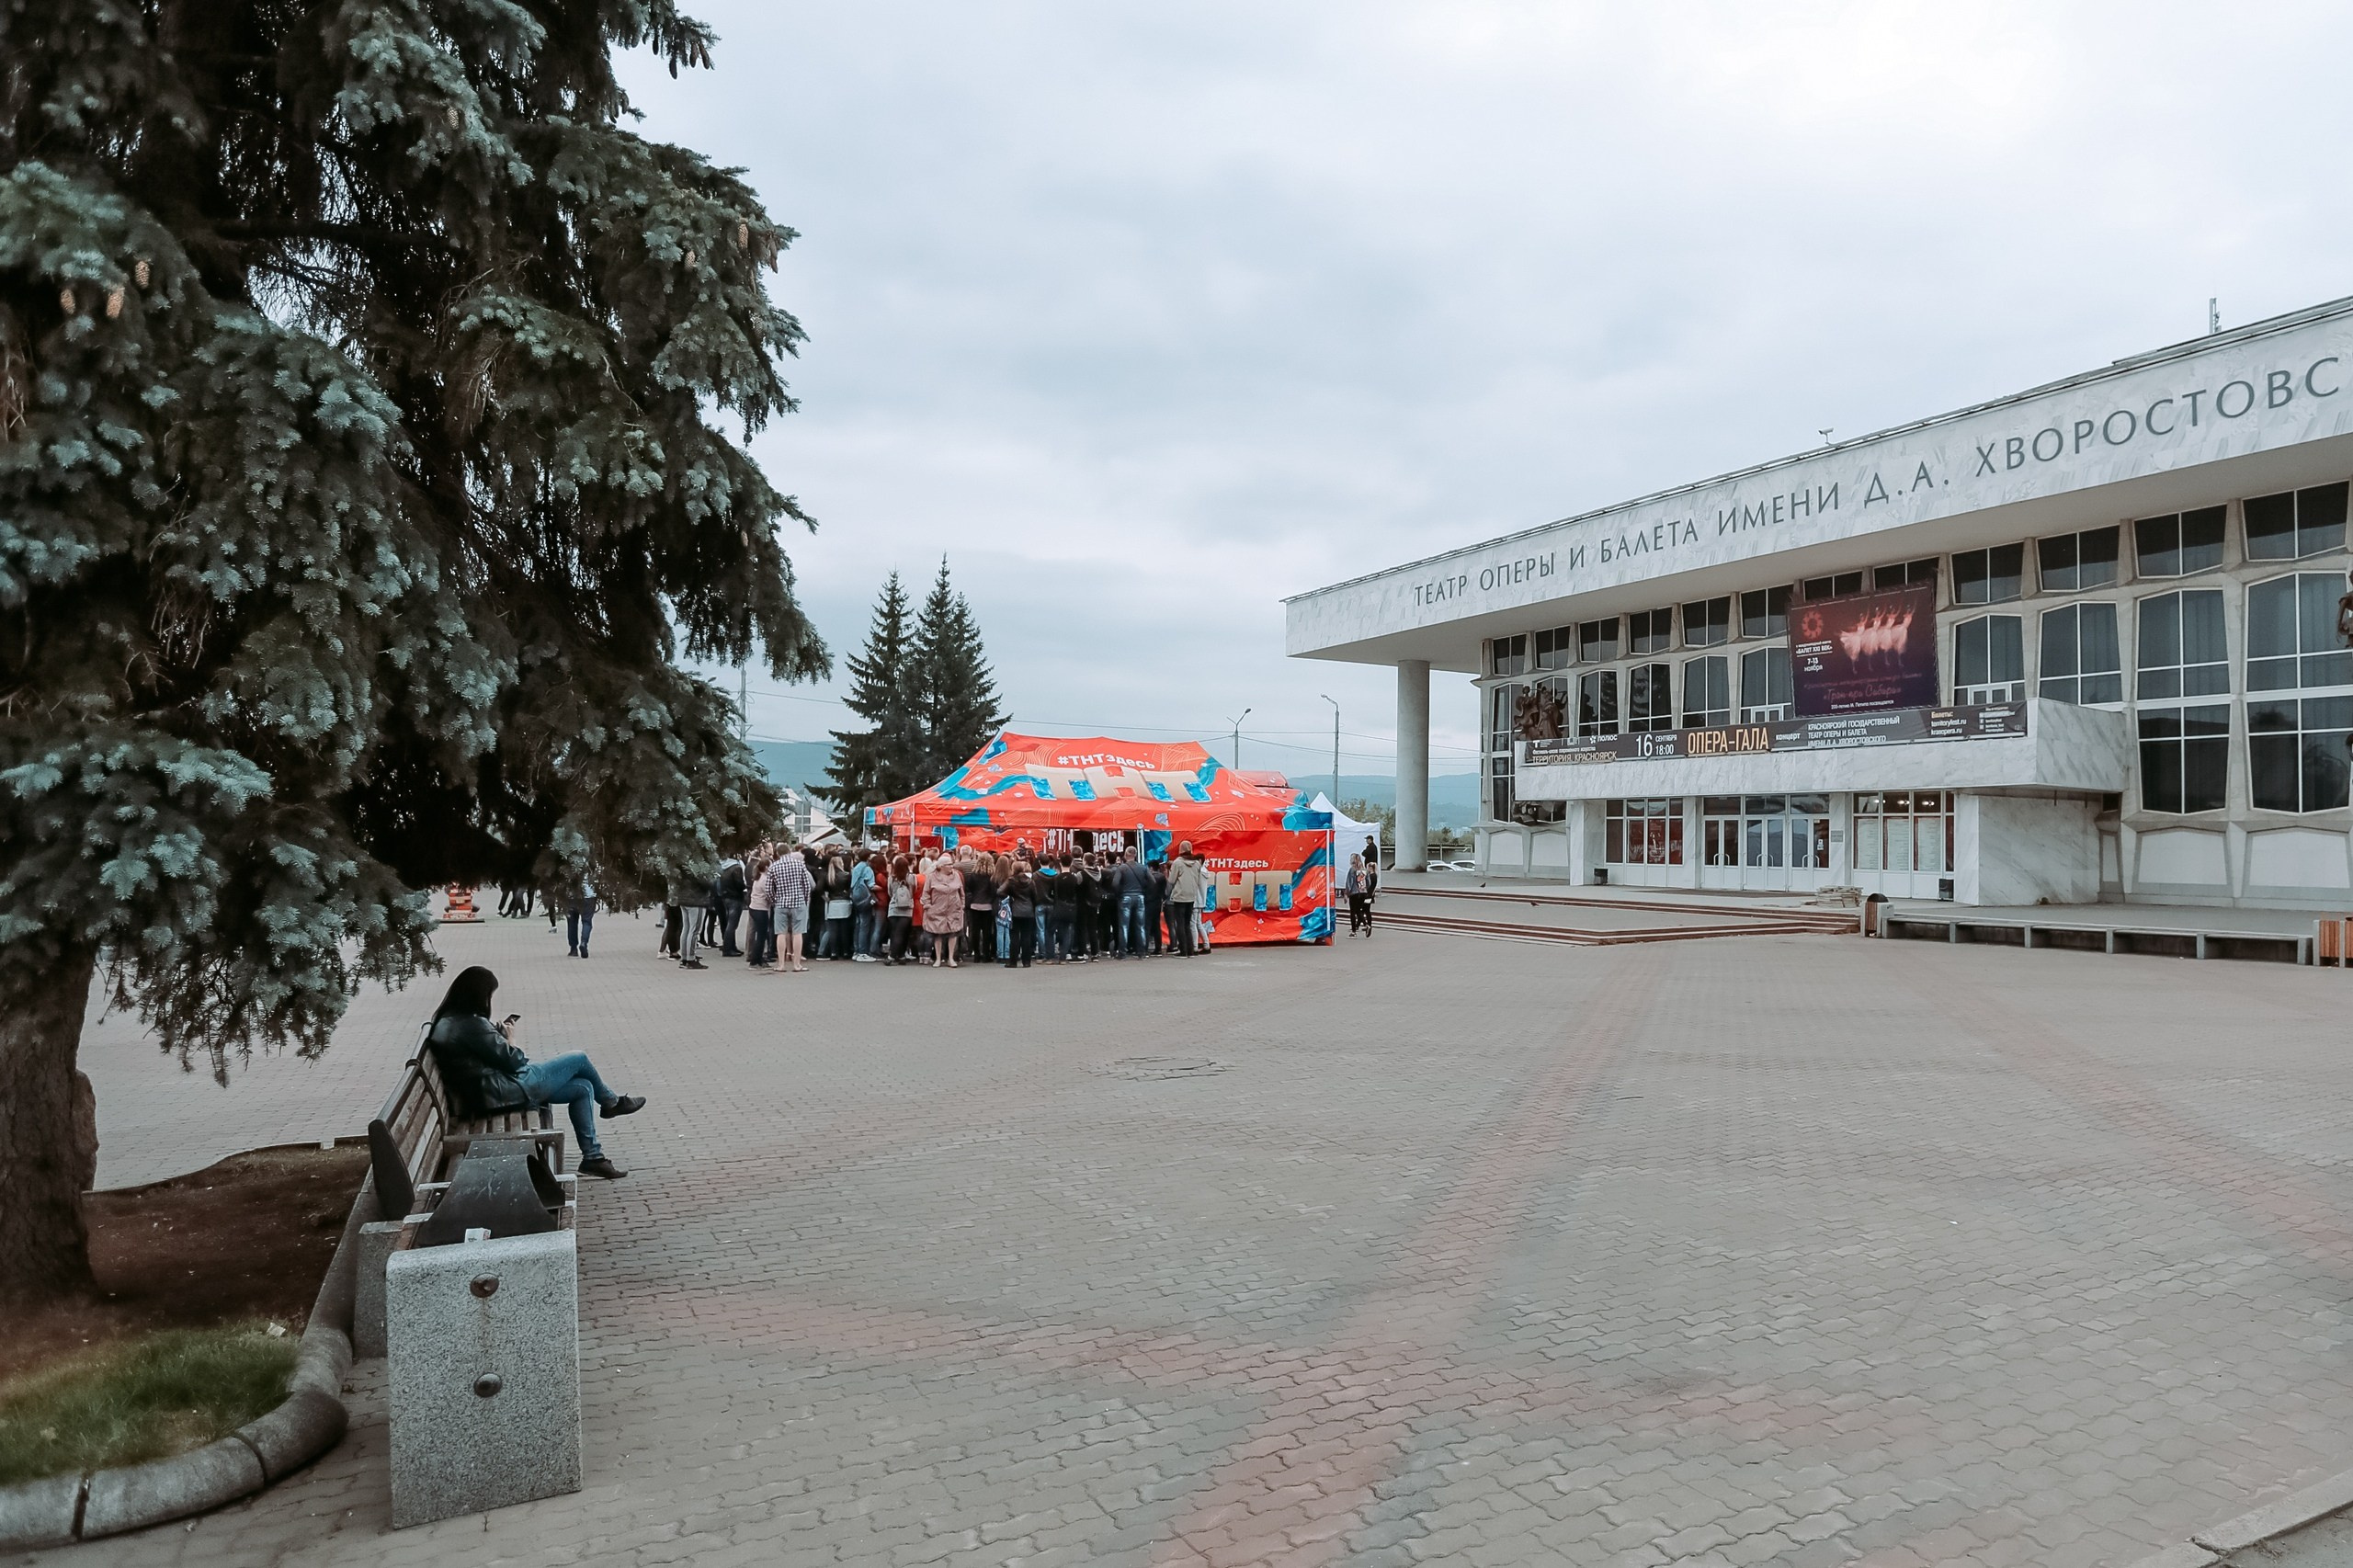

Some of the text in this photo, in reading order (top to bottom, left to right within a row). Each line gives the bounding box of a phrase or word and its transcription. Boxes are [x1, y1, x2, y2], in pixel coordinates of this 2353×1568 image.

[1415, 574, 1468, 608] ТЕАТР
[1479, 551, 1555, 591] ОПЕРЫ
[1569, 545, 1586, 570] И
[1600, 517, 1699, 563] БАЛЕТА
[1718, 482, 1838, 537] ИМЕНИ
[1975, 357, 2340, 478] ХВОРОСТОВС
[1808, 715, 1900, 731] КРАСНОЯРСКИЙ ГОСУДАРСТВЕННЫЙ
[1655, 734, 1677, 743] СЕНТЯБРЯ
[1688, 727, 1769, 754] ОПЕРА-ГАЛА
[1824, 730, 1841, 738] ОПЕРЫ
[1847, 728, 1868, 736] БАЛЕТА
[1636, 733, 1653, 756] 16
[1655, 744, 1675, 756] 18:00
[1058, 753, 1155, 769] #ТНТздесь
[1025, 763, 1212, 803] ТНТ
